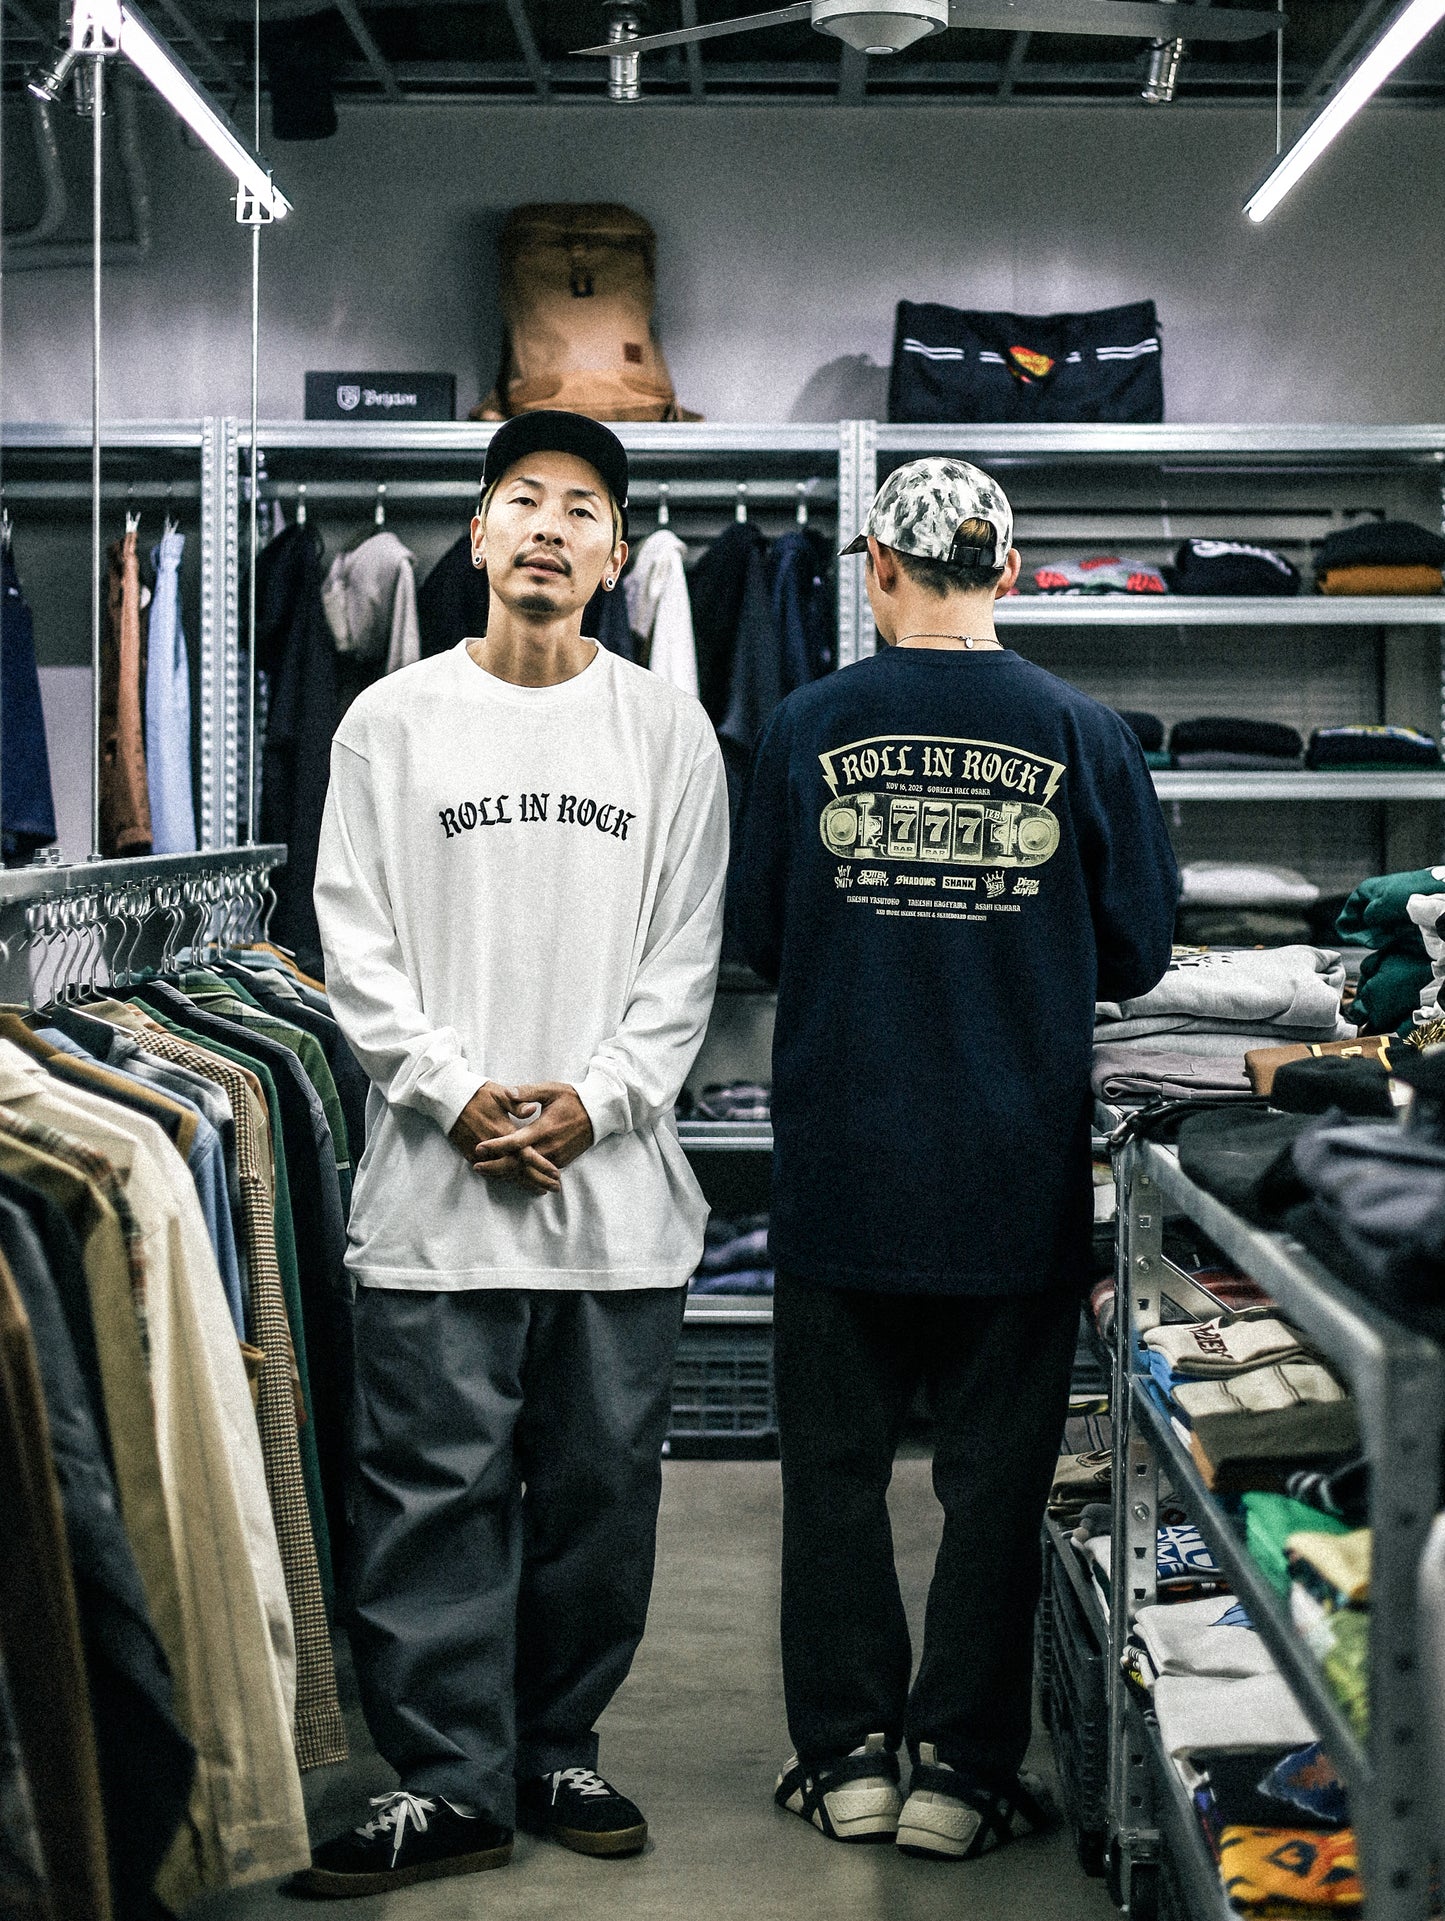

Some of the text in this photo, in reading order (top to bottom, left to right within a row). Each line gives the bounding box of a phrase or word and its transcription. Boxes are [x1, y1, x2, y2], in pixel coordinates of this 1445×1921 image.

[842, 745, 1044, 795] ROLL IN ROCK
[886, 782, 991, 796] NOV 16, 2025 GORILLA HALL OSAKA
[439, 793, 636, 840] ROLL IN ROCK
[893, 812, 982, 844] 7 7 7
[944, 878, 974, 889] SHANK
[1017, 877, 1040, 888] Dizzy
